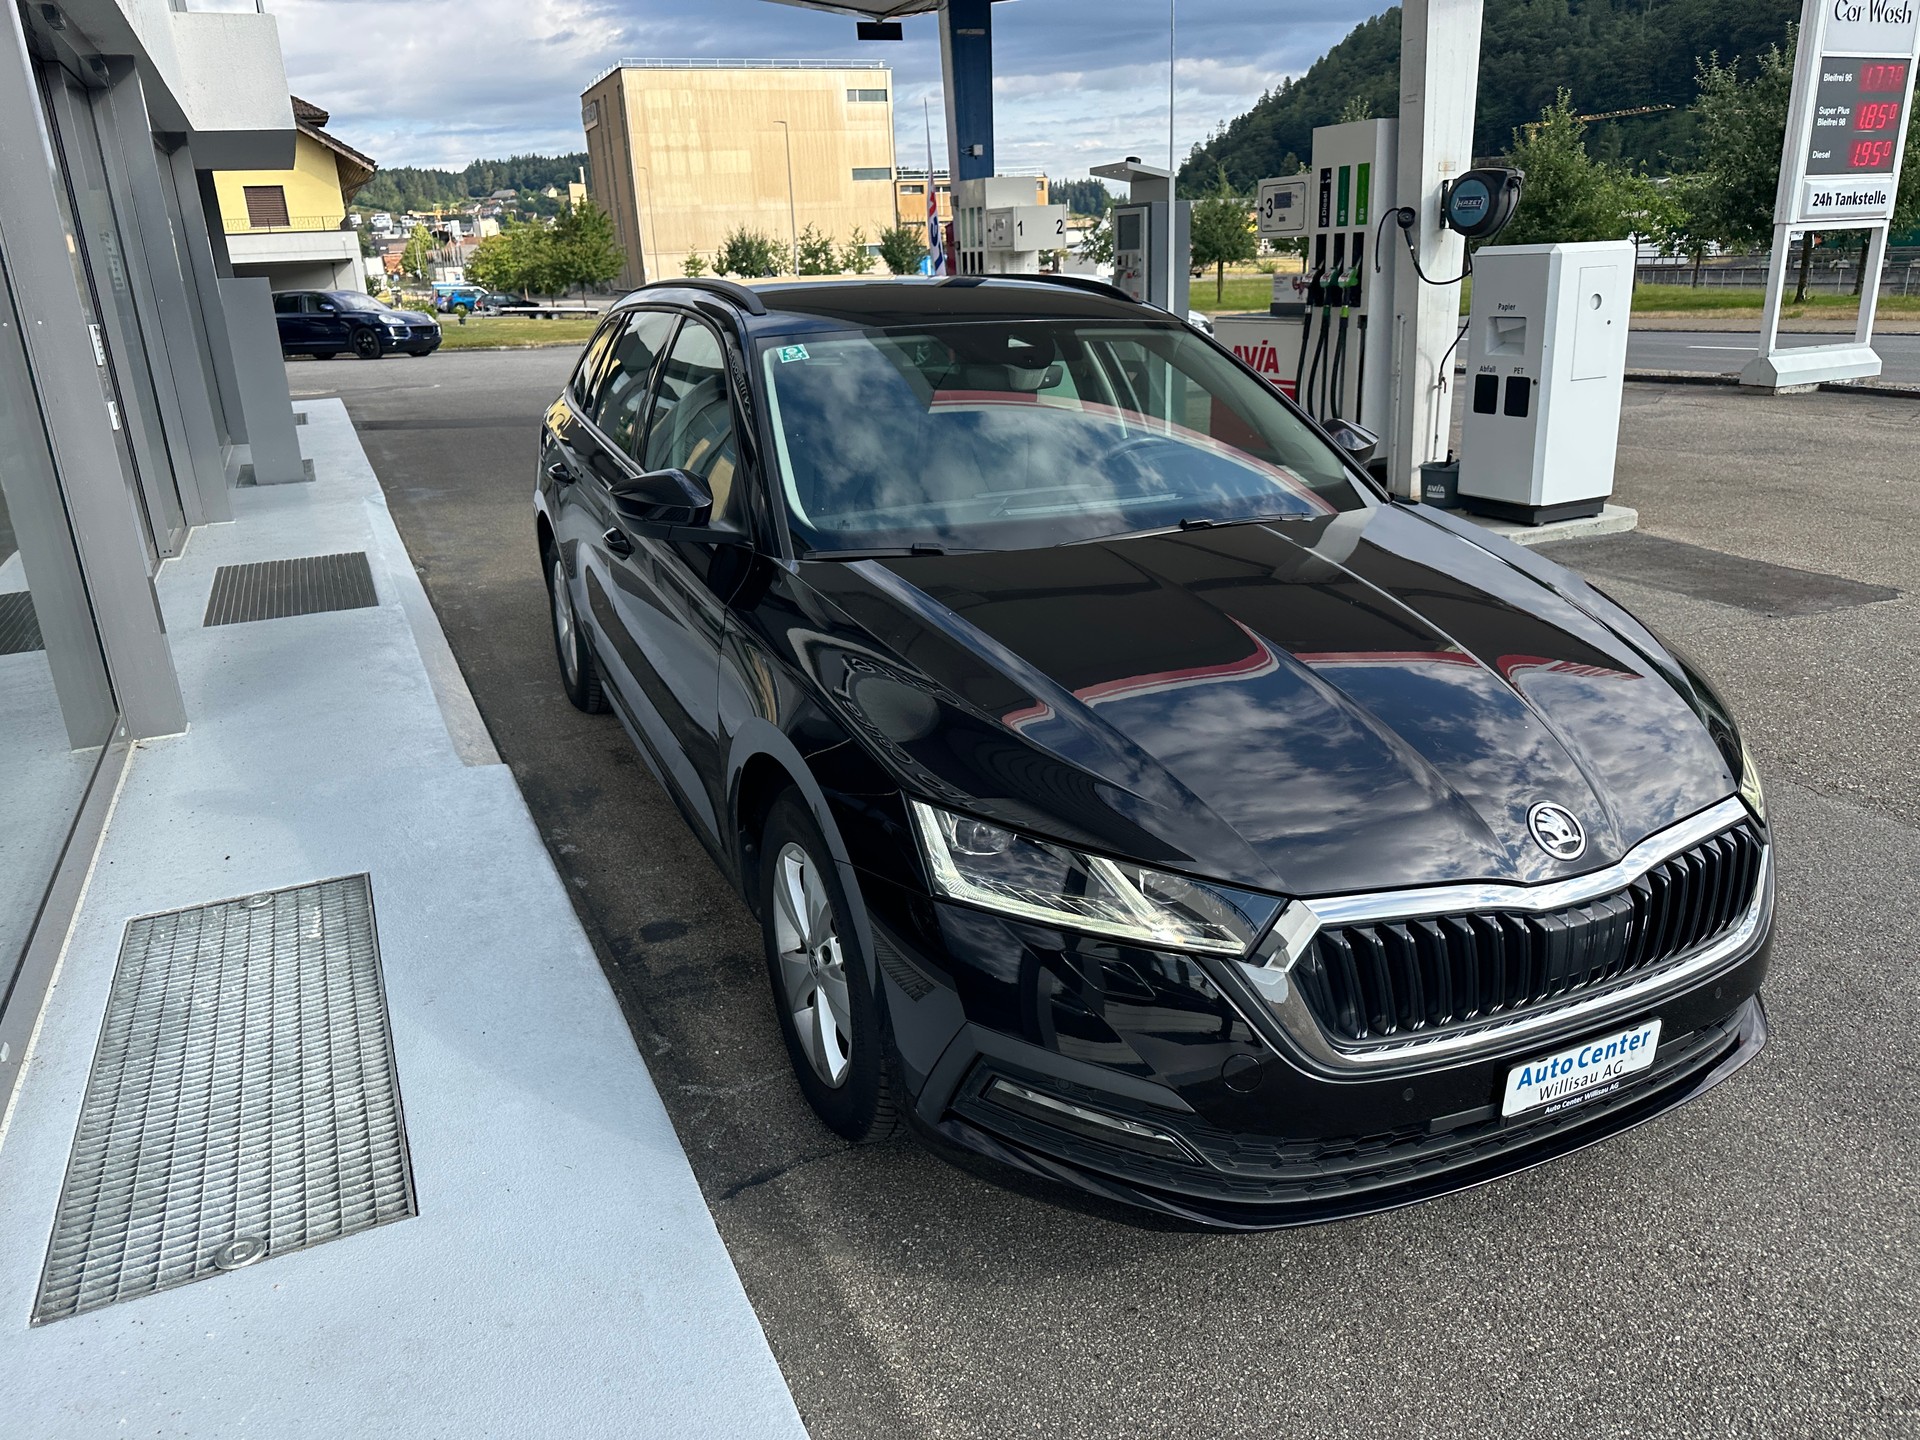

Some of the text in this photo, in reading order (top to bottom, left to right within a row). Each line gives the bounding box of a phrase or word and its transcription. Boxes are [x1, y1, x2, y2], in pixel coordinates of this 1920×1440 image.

[1834, 0, 1912, 24] Car Wash
[1823, 73, 1853, 82] Bleifrei 95
[1818, 106, 1851, 116] Super Plus
[1816, 118, 1847, 127] Bleifrei 98
[1811, 150, 1831, 159] Diesel
[1812, 190, 1887, 207] 24h Tankstelle
[1266, 198, 1273, 218] 3
[1017, 220, 1023, 236] 1
[1056, 219, 1063, 235] 2
[1497, 302, 1516, 312] Papier
[1479, 365, 1497, 374] Abfall
[1513, 366, 1524, 375] PET
[1516, 1030, 1652, 1091] Auto Center
[1539, 1060, 1624, 1101] Willisau AG
[1544, 1081, 1620, 1115] Auto Center Willisau AG
